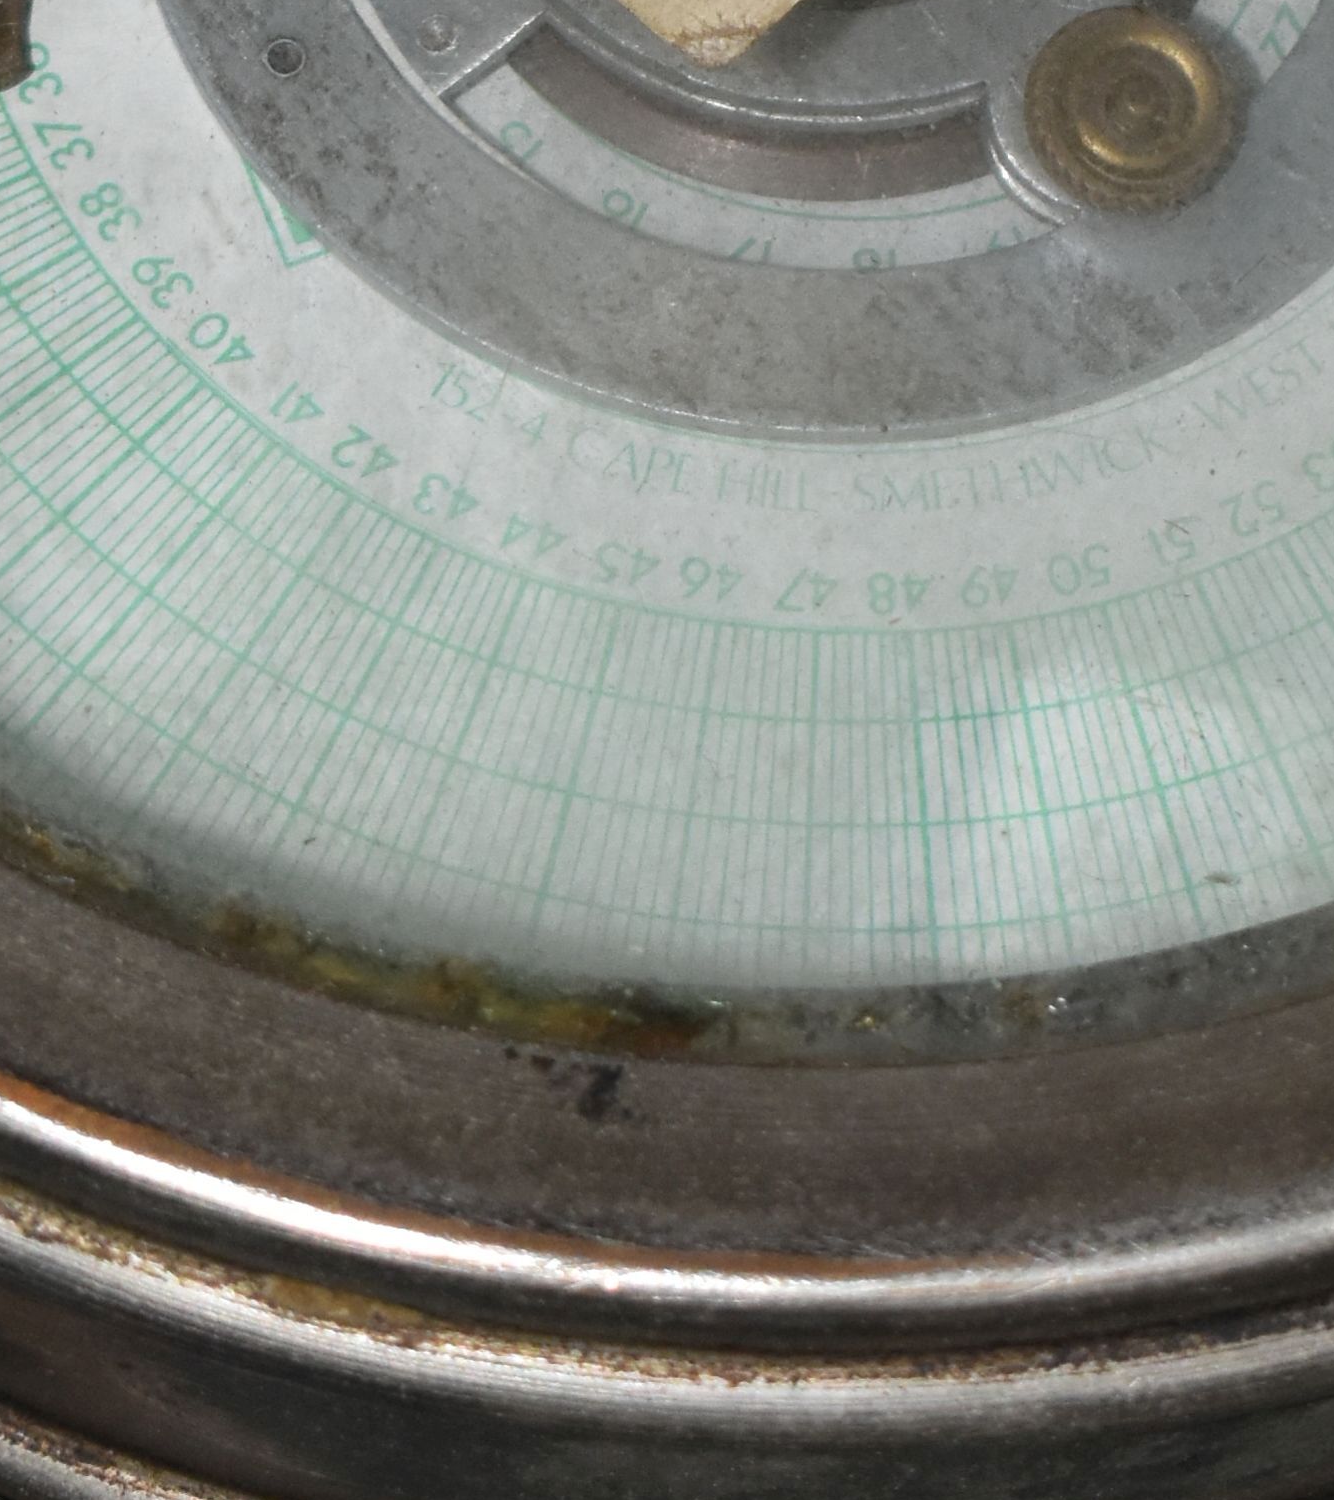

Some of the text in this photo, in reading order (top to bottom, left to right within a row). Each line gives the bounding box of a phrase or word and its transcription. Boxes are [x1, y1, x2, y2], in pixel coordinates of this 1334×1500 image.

[32, 121, 97, 172] 37
[77, 180, 144, 244] 38
[130, 254, 196, 311] 39
[186, 311, 257, 366] 40
[269, 378, 326, 425] 41
[329, 421, 402, 480] 42
[411, 471, 481, 522] 43
[498, 512, 569, 559] 44
[594, 539, 663, 586] 45
[678, 554, 746, 604] 46
[772, 565, 841, 615] 47
[865, 569, 935, 617] 48
[960, 562, 1021, 610] 49
[1045, 540, 1115, 598] 50
[1145, 514, 1201, 568] 51
[1217, 477, 1288, 539] 52
[567, 424, 695, 499] CAPE
[716, 459, 823, 516] HILL
[1190, 332, 1325, 434] WEST
